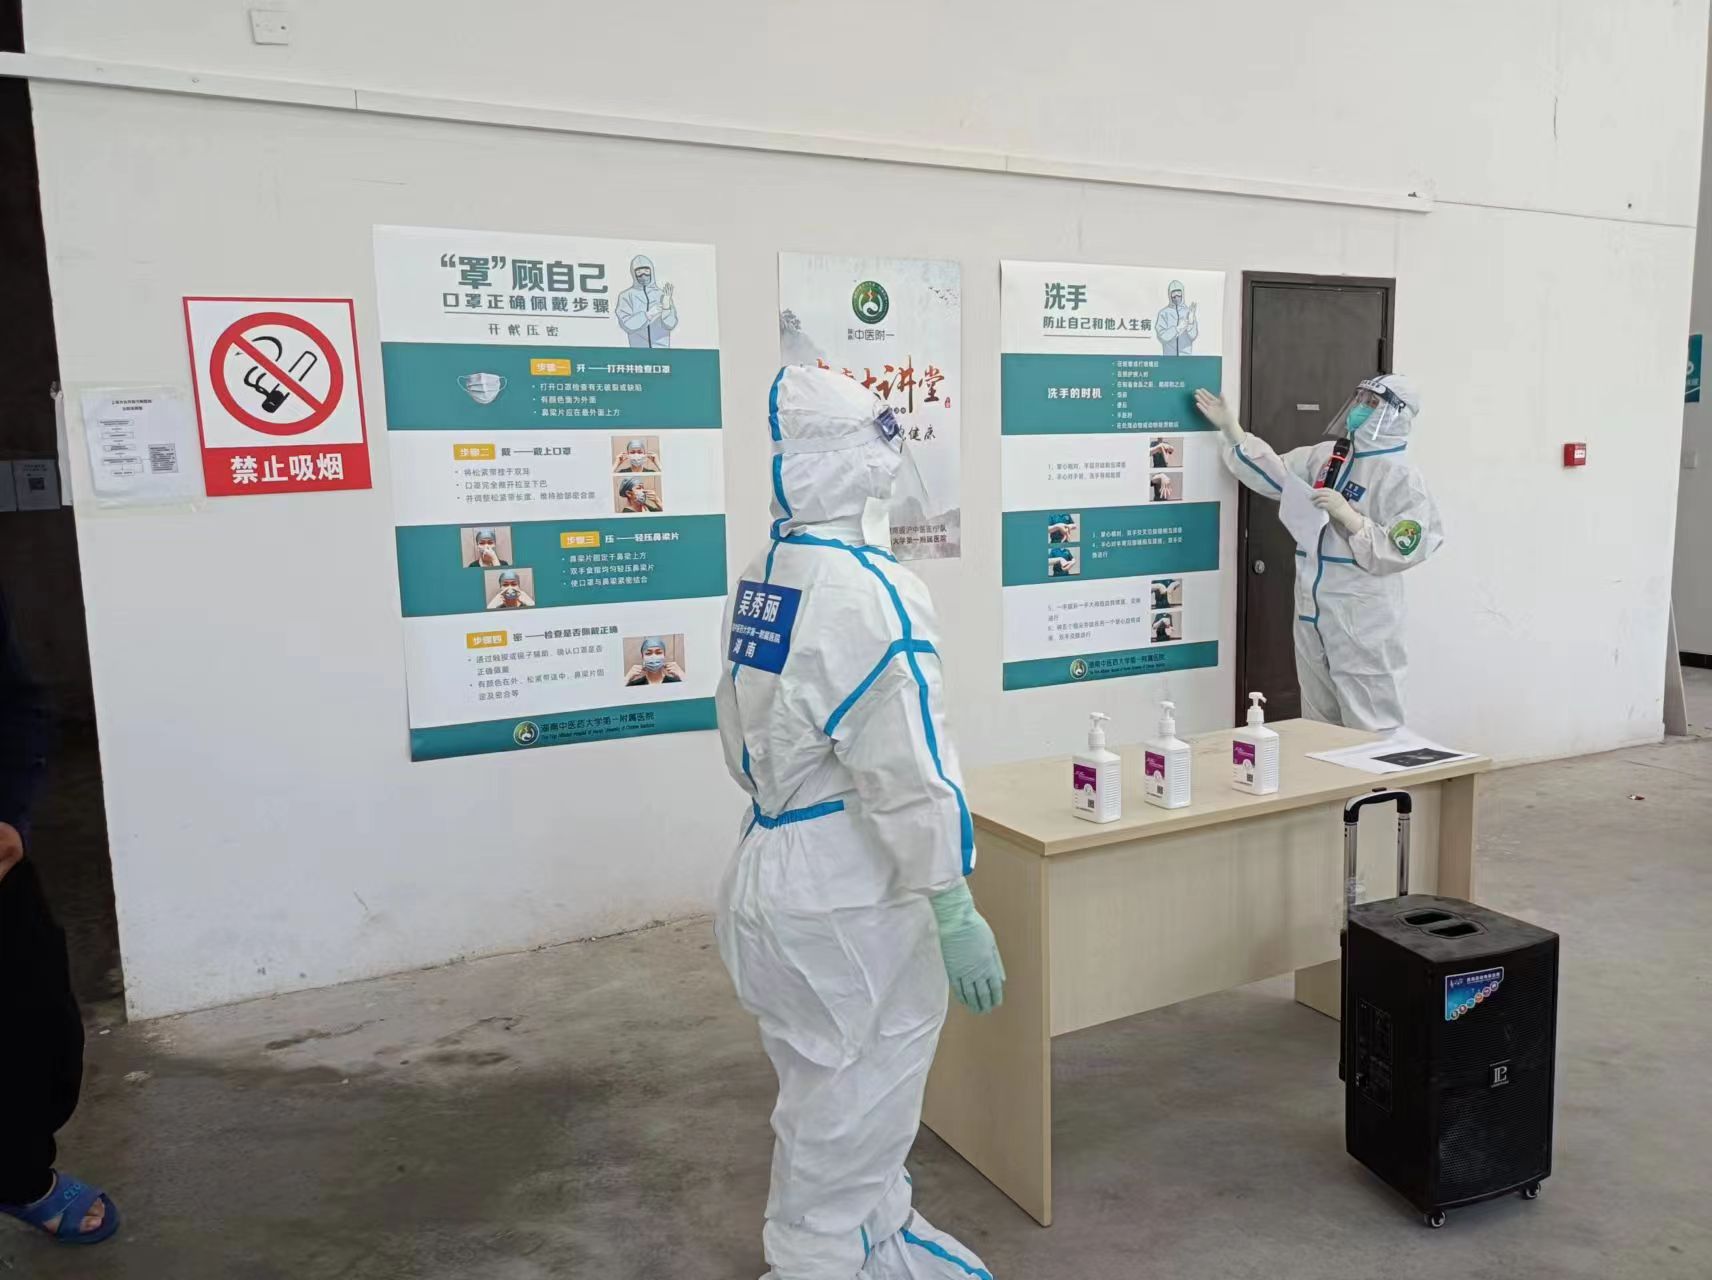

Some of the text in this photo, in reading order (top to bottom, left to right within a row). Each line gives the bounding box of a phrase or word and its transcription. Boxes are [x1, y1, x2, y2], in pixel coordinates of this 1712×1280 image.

[440, 253, 608, 294] “罩”顾自己
[442, 292, 610, 315] 口罩正确佩戴步骤
[1044, 282, 1087, 311] 洗手
[1043, 316, 1152, 331] 防止自己和他人生病
[1048, 387, 1102, 399] 洗手的时机
[230, 452, 344, 484] 禁止吸烟
[738, 590, 782, 622] 吴秀丽
